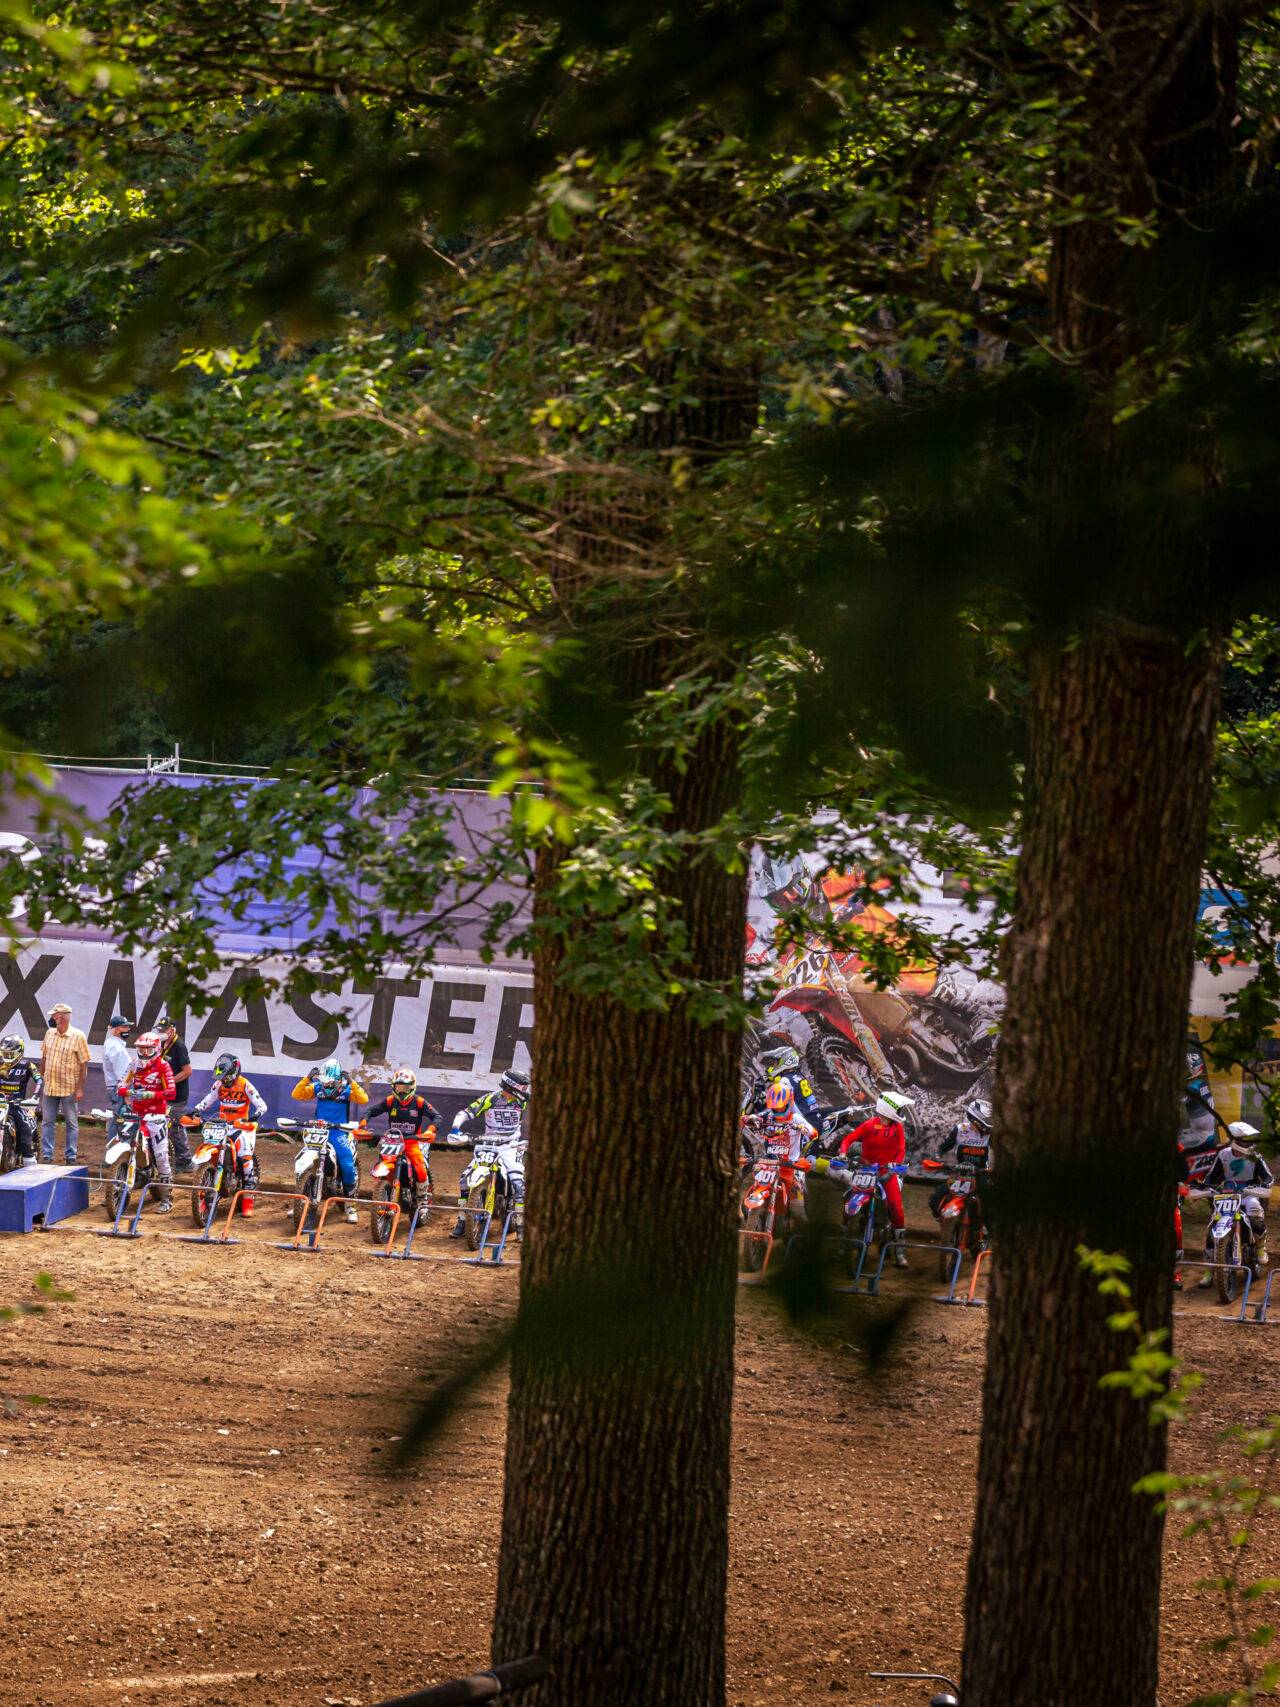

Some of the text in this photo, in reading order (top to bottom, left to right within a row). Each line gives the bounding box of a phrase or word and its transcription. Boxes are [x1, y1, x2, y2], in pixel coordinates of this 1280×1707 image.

[9, 1068, 27, 1076] FOX
[121, 1121, 135, 1133] 7
[304, 1133, 327, 1144] 437
[380, 1143, 402, 1155] 771
[477, 1150, 495, 1163] 36
[754, 1169, 777, 1184] 401
[852, 1174, 877, 1187] 601
[950, 1180, 972, 1193] 44
[1216, 1200, 1238, 1211] 701
